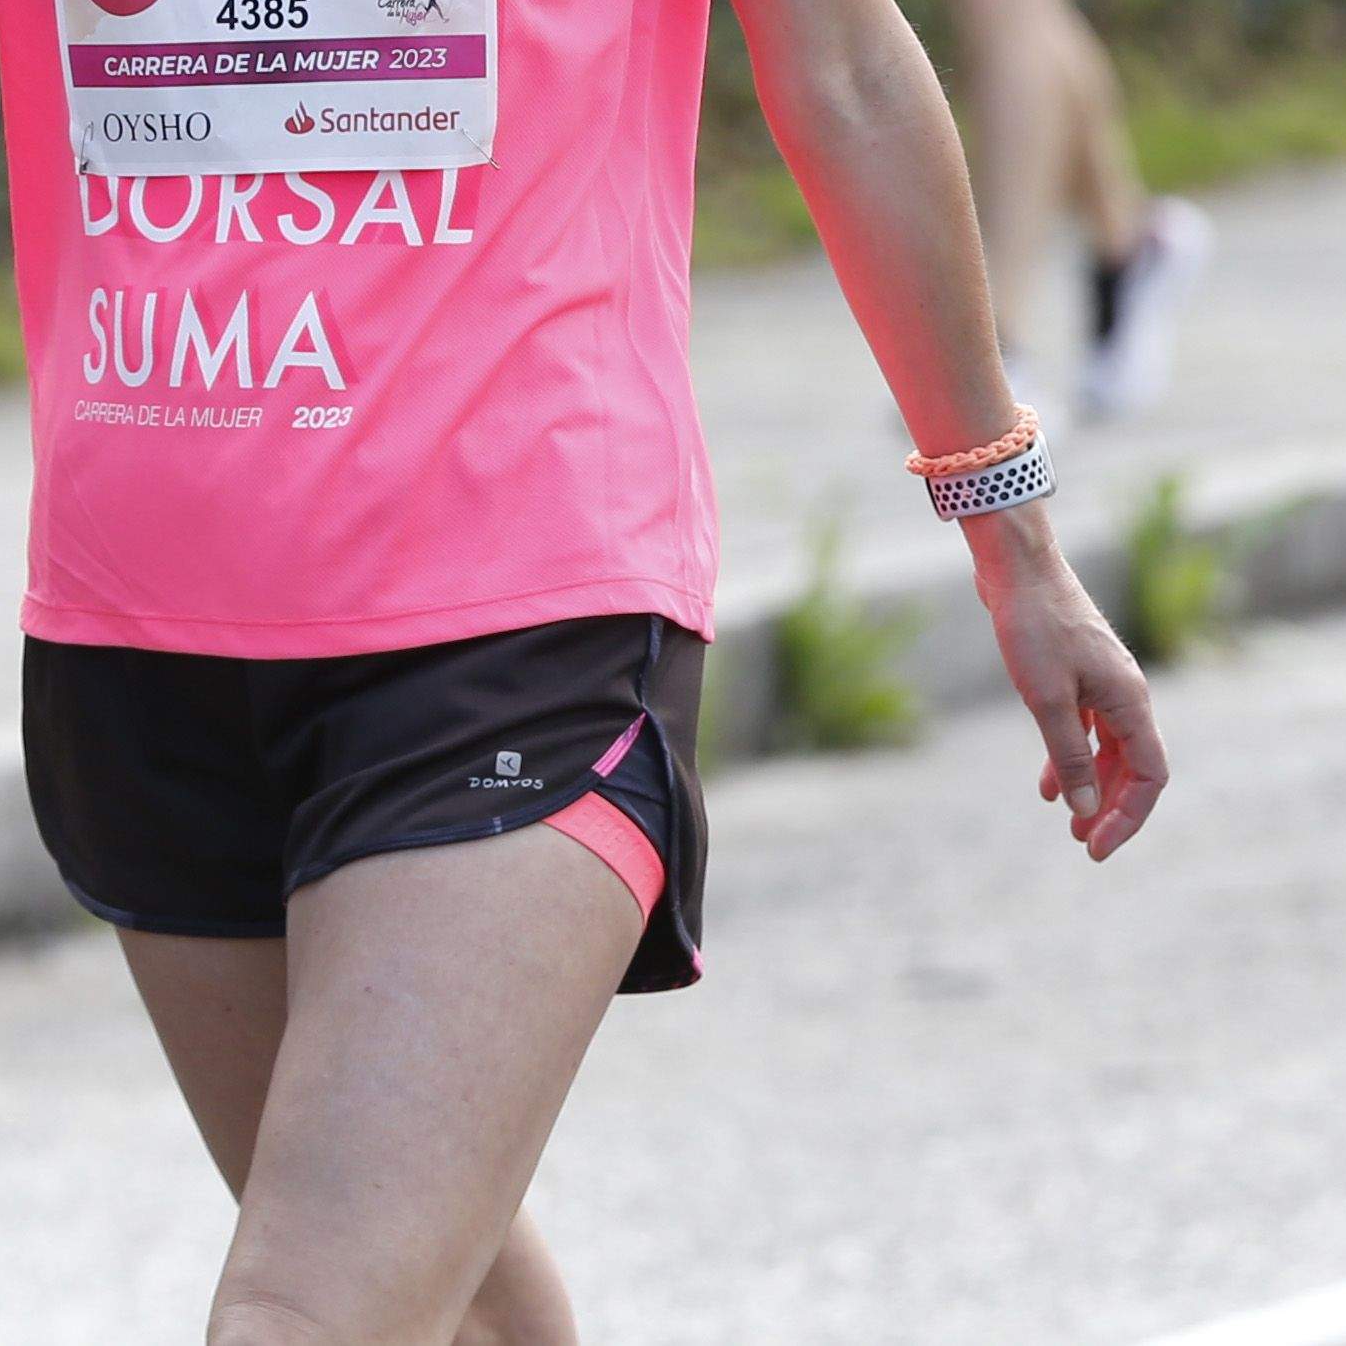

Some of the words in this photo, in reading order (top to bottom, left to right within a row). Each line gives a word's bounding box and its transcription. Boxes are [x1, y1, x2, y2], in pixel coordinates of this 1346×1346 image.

[104, 55, 208, 77] CARRERA
[214, 54, 250, 74] DE
[256, 52, 288, 72] LA
[294, 49, 380, 71] MUJER
[389, 48, 447, 69] 2023
[104, 112, 211, 142] OYSHO
[320, 106, 460, 134] Santander
[80, 168, 475, 247] DORSAL
[83, 287, 346, 391] SUMA
[74, 401, 134, 424] CARRERA
[137, 405, 161, 426] DE
[164, 406, 185, 426] LA
[190, 407, 263, 428] MUJER
[292, 406, 353, 429] 2023
